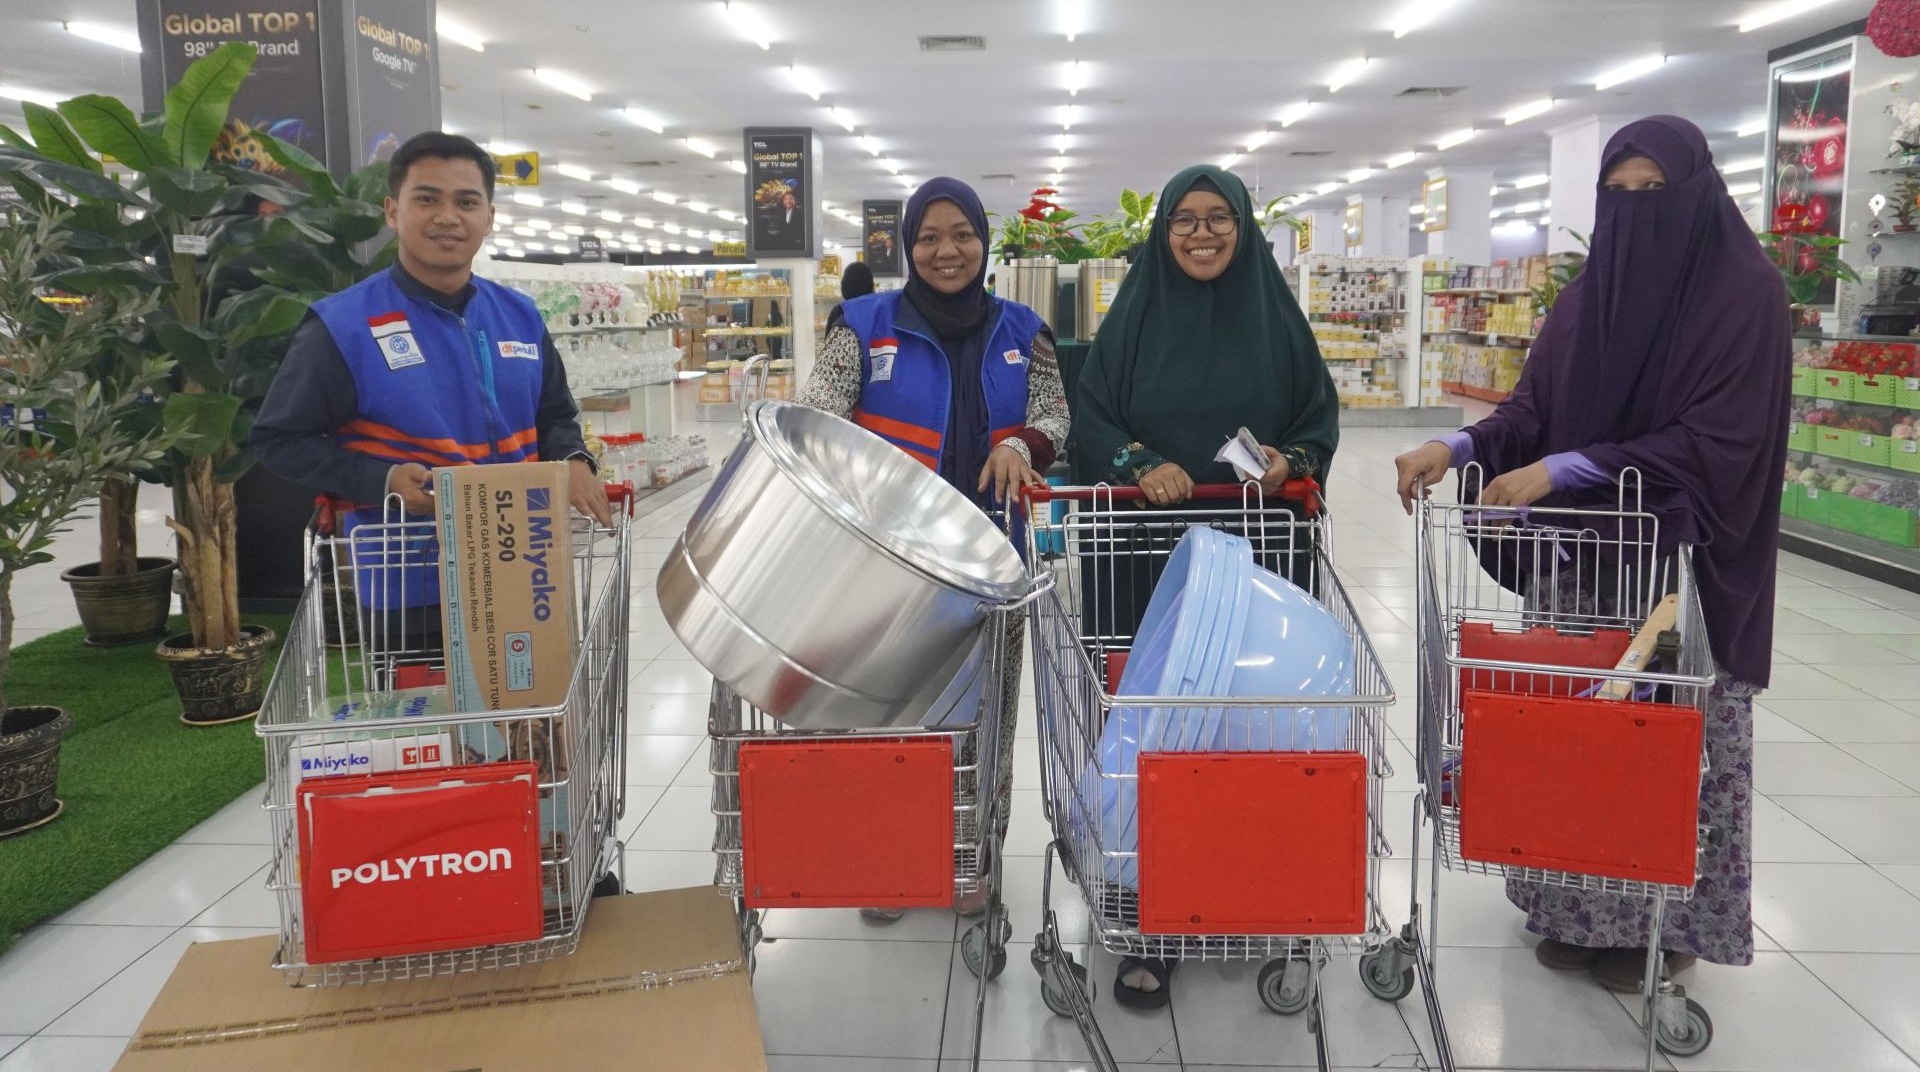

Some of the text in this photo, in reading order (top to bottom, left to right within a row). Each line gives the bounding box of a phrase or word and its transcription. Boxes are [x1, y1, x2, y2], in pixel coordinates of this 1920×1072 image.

[165, 11, 316, 35] Global TOP 1
[357, 15, 396, 47] Global
[398, 32, 422, 57] TOP
[372, 46, 402, 69] Google
[754, 153, 778, 161] Global
[478, 483, 488, 526] KOMPOR
[481, 529, 489, 549] GAS
[495, 490, 516, 562] SL-290
[463, 484, 479, 632] Bahan Bakar LPG Tekanan Rendah
[523, 517, 557, 621] Miyako
[482, 551, 493, 609] KOMERSIAL
[486, 611, 494, 633] BESI
[487, 636, 496, 658] COR
[489, 659, 498, 685] SATU
[313, 753, 369, 771] Miyako
[331, 847, 512, 889] POLYTRON
